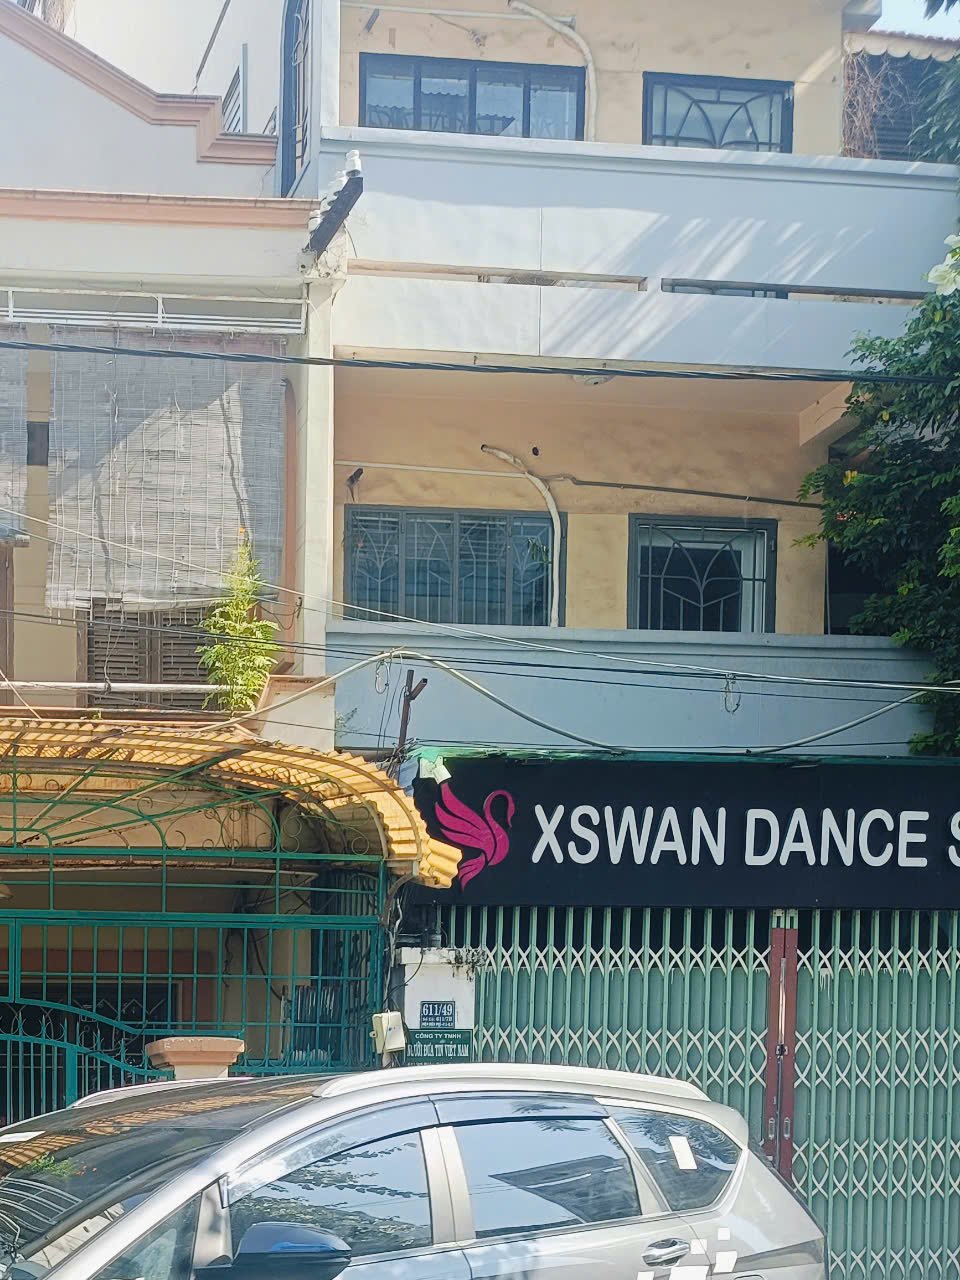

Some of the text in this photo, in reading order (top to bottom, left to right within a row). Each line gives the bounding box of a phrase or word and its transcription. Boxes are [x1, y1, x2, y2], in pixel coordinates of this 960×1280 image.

[531, 804, 727, 866] XSWAN
[744, 807, 930, 868] DANCE
[422, 1003, 453, 1016] 611/49
[457, 1044, 469, 1057] NAM
